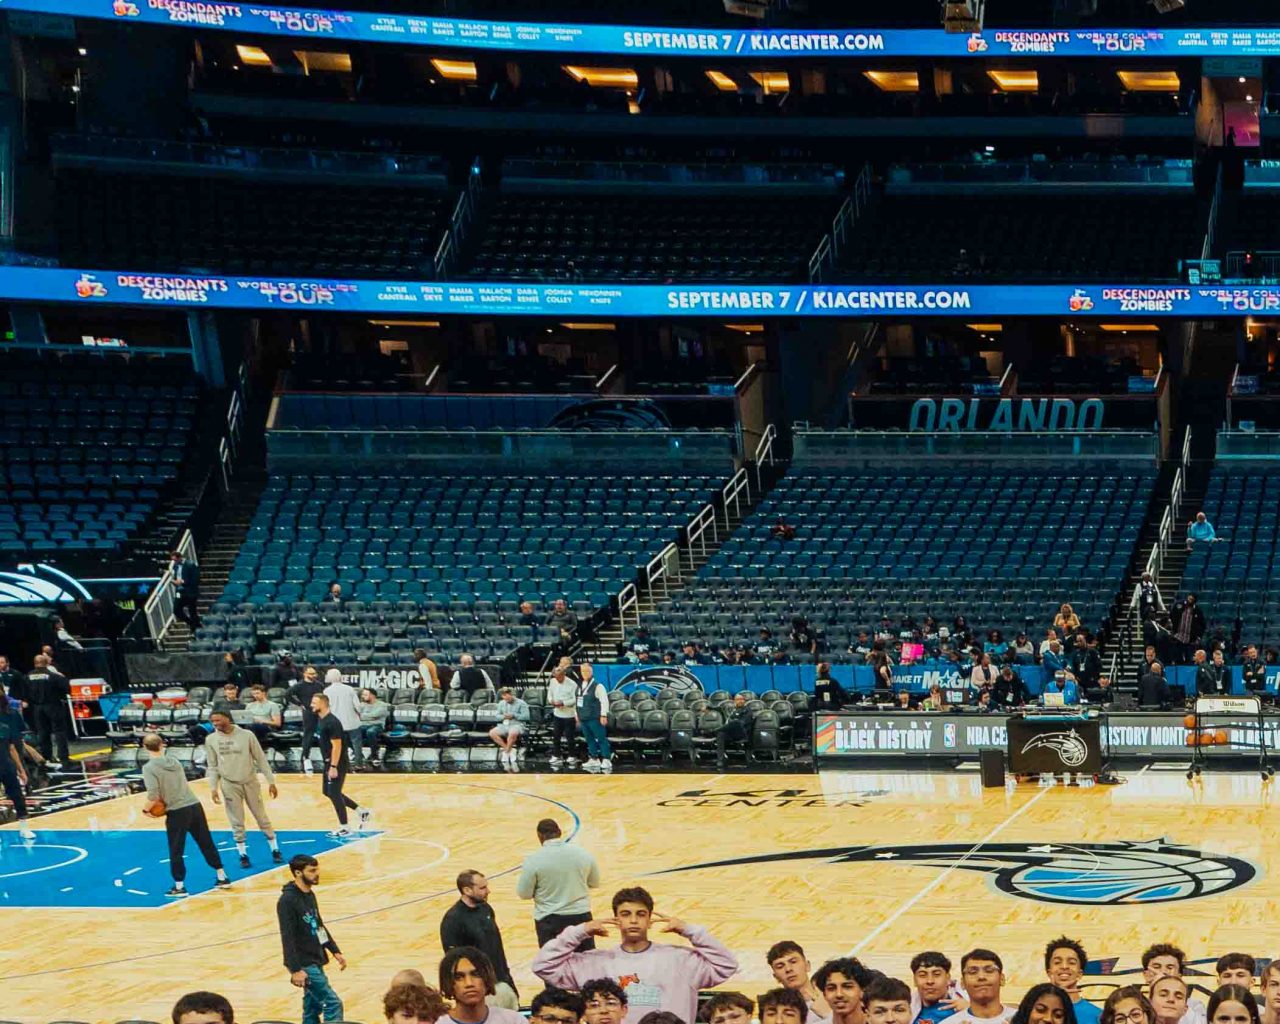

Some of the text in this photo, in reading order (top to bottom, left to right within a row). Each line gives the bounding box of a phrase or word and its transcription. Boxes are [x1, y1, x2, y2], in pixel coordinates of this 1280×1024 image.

[148, 0, 242, 18] DESCENDANTS
[169, 11, 225, 26] ZOMBIES
[269, 16, 334, 33] TOUR
[623, 31, 718, 51] SEPTEMBER
[721, 34, 733, 51] 7
[750, 33, 885, 52] KIACENTER.COM
[995, 32, 1070, 44] DESCENDANTS
[1076, 33, 1119, 41] WORLDS
[1091, 38, 1147, 52] TOUR
[1010, 41, 1055, 53] ZOMBIES
[117, 274, 229, 293] DESCENDANTS
[236, 281, 297, 292] WORLDS
[142, 286, 209, 303] ZOMBIES
[260, 288, 335, 306] TOUR
[668, 291, 774, 309] SEPTEMBER
[779, 291, 791, 309] 7
[813, 291, 971, 309] KIACENTER.COM
[1102, 288, 1191, 301] DESCENDANTS
[1199, 289, 1250, 298] WORLDS
[1120, 298, 1174, 312] ZOMBIES
[1217, 296, 1280, 311] TOUR
[908, 397, 1106, 432] ORLANDO
[360, 667, 421, 691] MAGIC
[891, 668, 971, 690] MAKE IT MAGI
[835, 721, 932, 729] BUILT BY
[879, 729, 932, 749] HISTORY
[966, 727, 990, 746] NBA
[656, 799, 873, 808] CENTER
